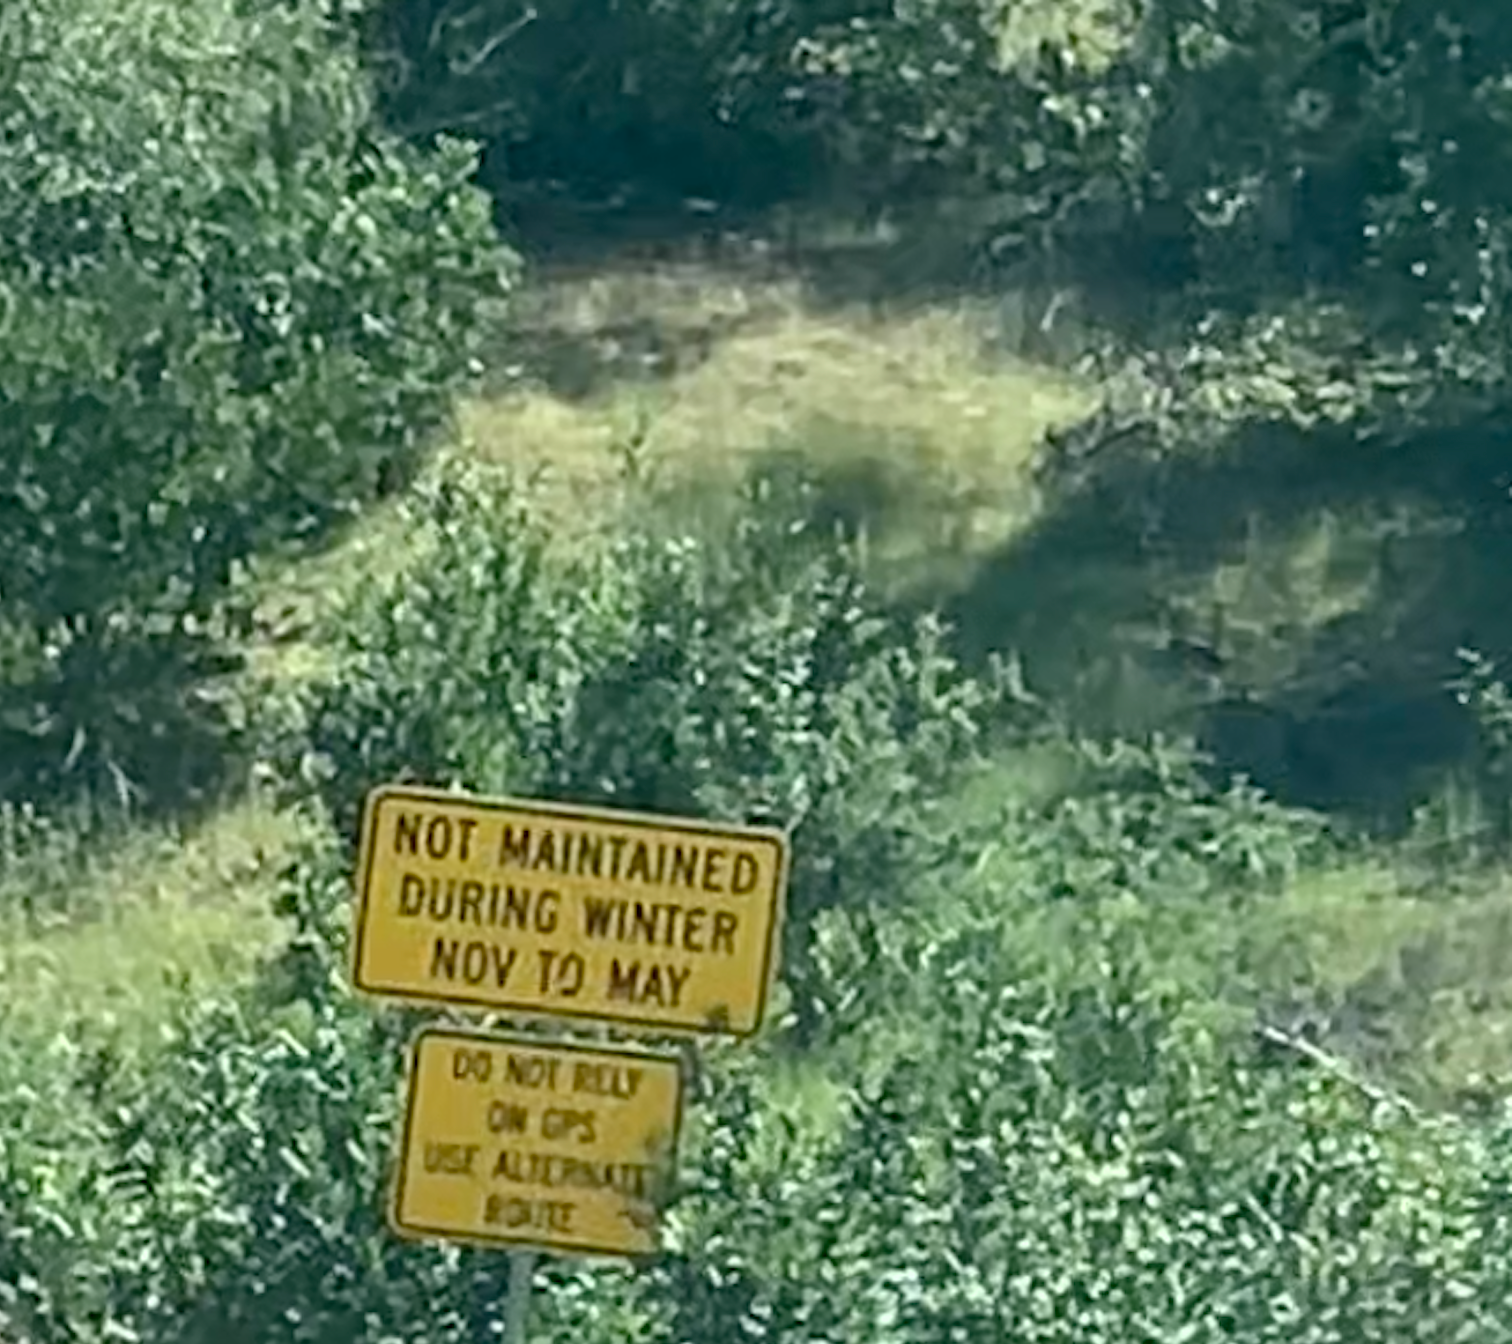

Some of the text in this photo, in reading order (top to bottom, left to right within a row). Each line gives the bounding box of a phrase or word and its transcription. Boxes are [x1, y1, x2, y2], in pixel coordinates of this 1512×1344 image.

[394, 812, 760, 896] NOT MAINTAINED
[398, 873, 739, 956] DURING WINTER
[430, 937, 692, 1008] NOV TO MAY
[453, 1047, 493, 1083] DO
[504, 1053, 561, 1091] NOT
[487, 1100, 596, 1144] ON GPS
